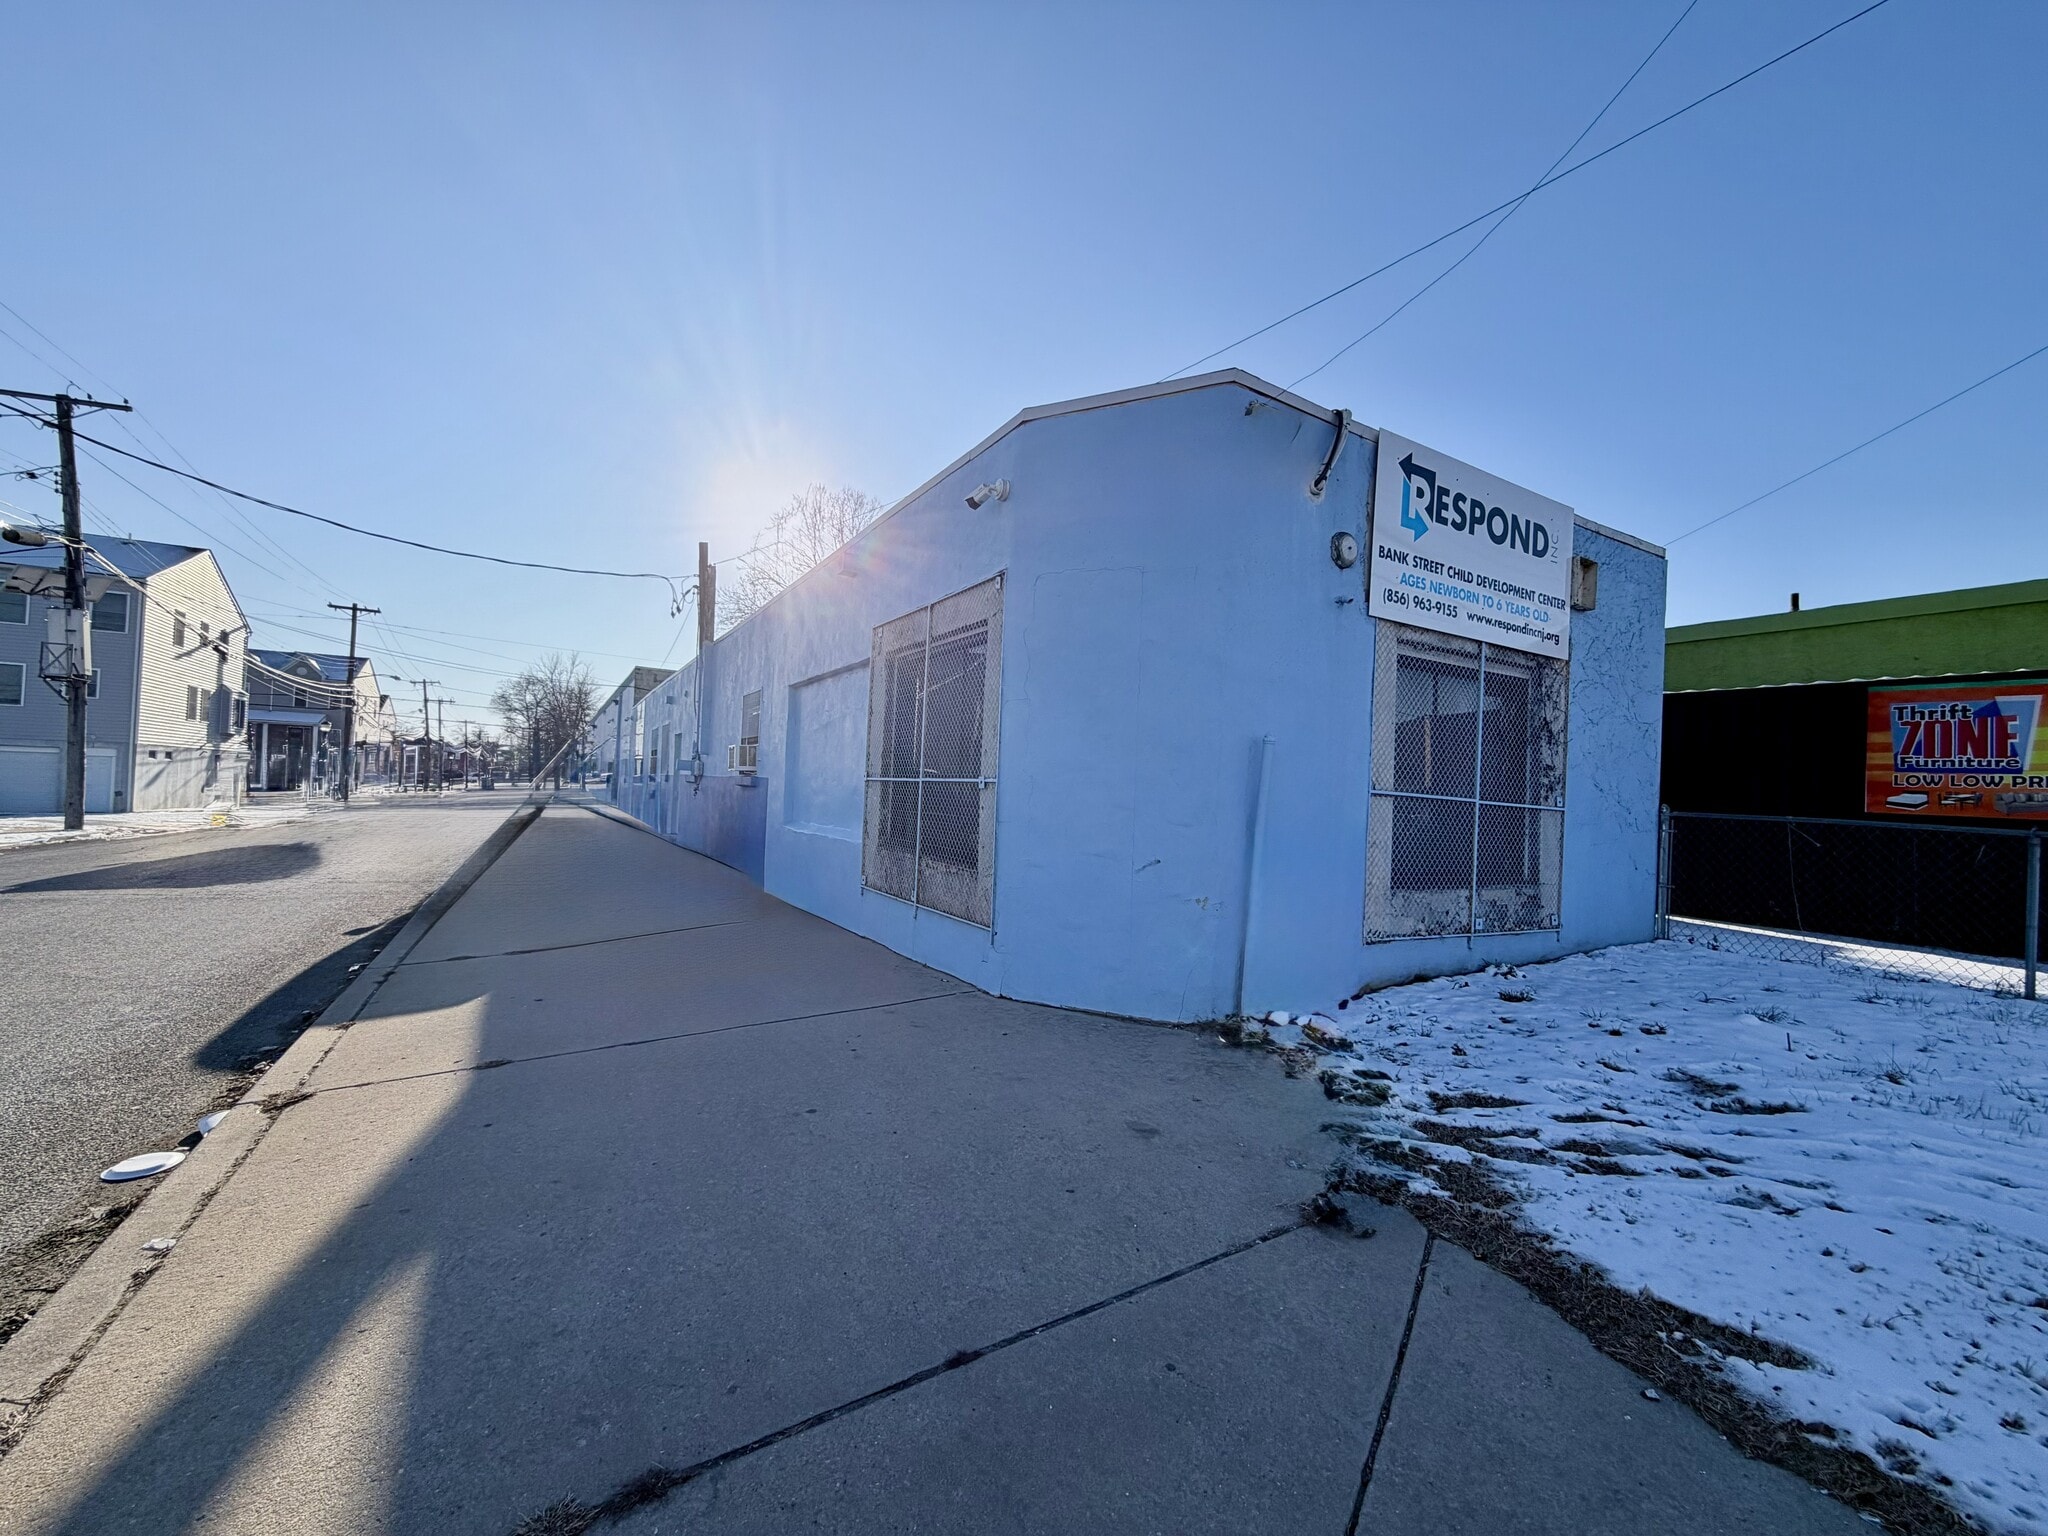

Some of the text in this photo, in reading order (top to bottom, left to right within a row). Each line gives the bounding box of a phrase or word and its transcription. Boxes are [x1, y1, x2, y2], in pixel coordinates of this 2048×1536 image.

[1408, 472, 1549, 558] RESPOND
[1378, 545, 1566, 611] BANK STREET CHILD DEVELOPMENT CENTER
[1400, 572, 1549, 623] AGES NEWBORN TO 6 YEARS OLD
[1383, 588, 1560, 646] (856) 963-9155 www.respondincnj.org
[1893, 704, 1974, 722] Thrift
[1900, 715, 2019, 759] ZONE
[1893, 775, 1943, 788] LOW
[1950, 775, 2004, 788] LOW
[1899, 755, 2021, 769] Furniture
